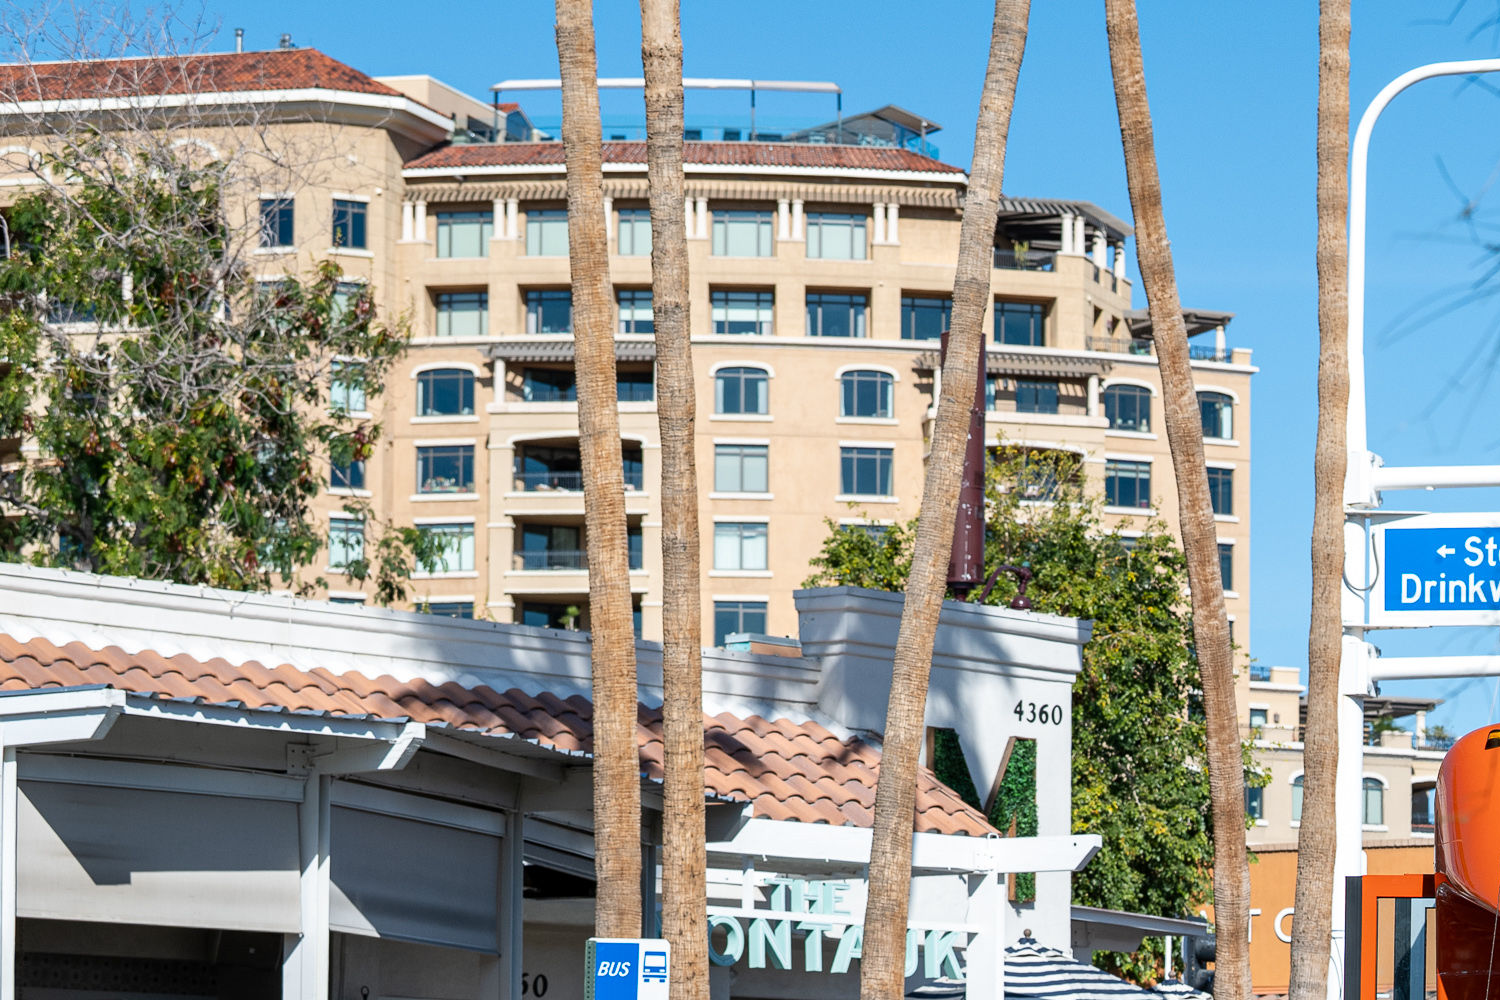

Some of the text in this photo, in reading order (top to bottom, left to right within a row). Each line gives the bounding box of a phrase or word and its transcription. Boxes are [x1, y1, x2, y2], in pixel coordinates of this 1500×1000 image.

[1013, 699, 1063, 726] 4360
[764, 877, 851, 915] THE
[706, 913, 967, 980] ONTAK
[597, 961, 631, 978] BUS
